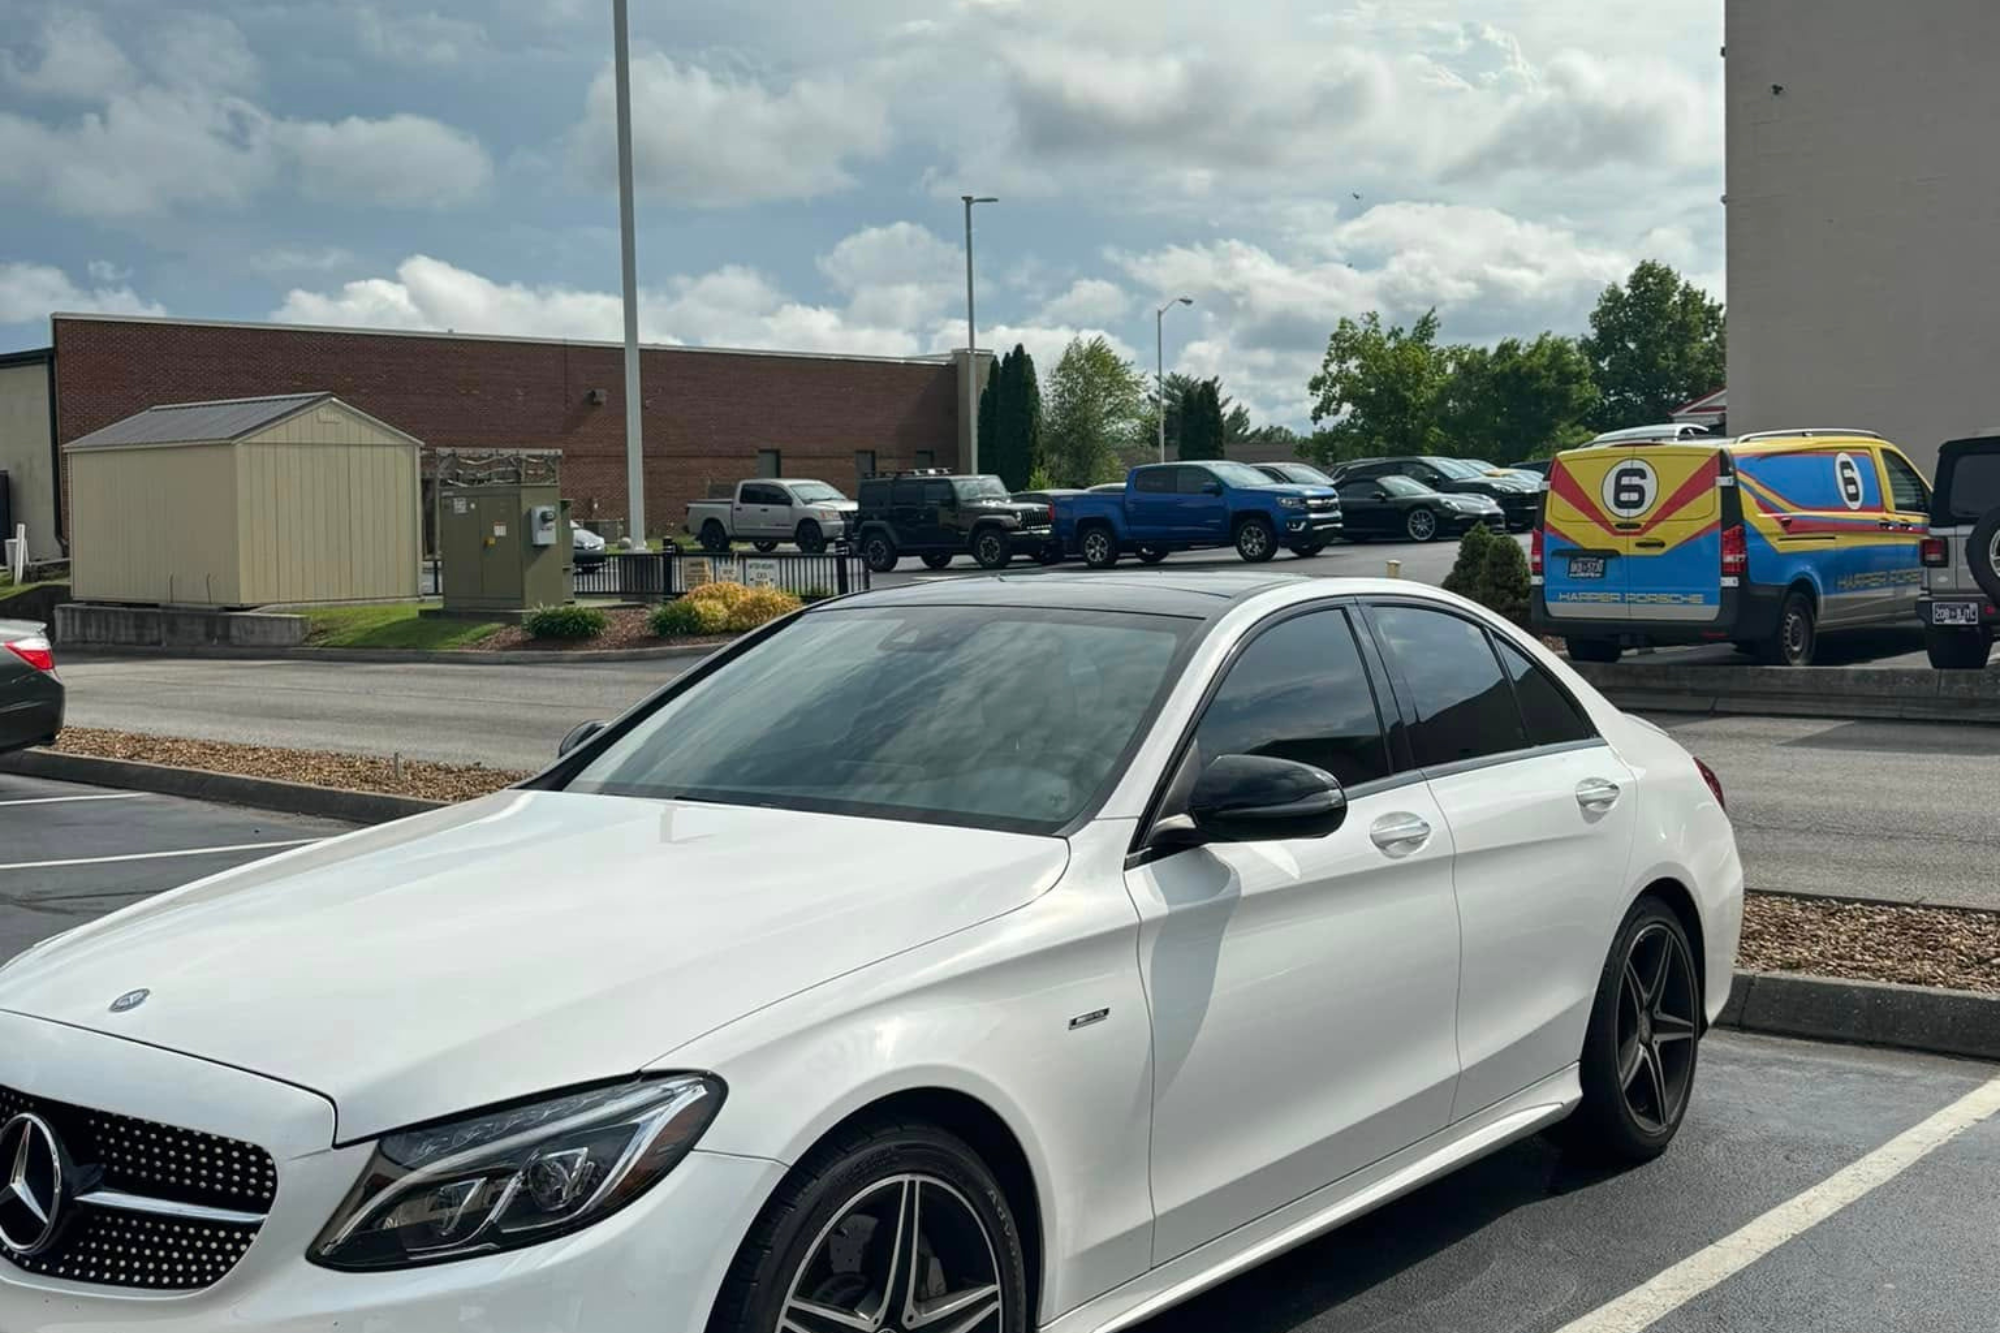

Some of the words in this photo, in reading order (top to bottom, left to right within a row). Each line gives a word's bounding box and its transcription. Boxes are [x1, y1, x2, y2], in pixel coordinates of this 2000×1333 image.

[1614, 468, 1646, 509] 6
[1840, 460, 1860, 502] 6
[1559, 592, 1620, 603] HARPER
[1625, 593, 1704, 604] PORSCHE
